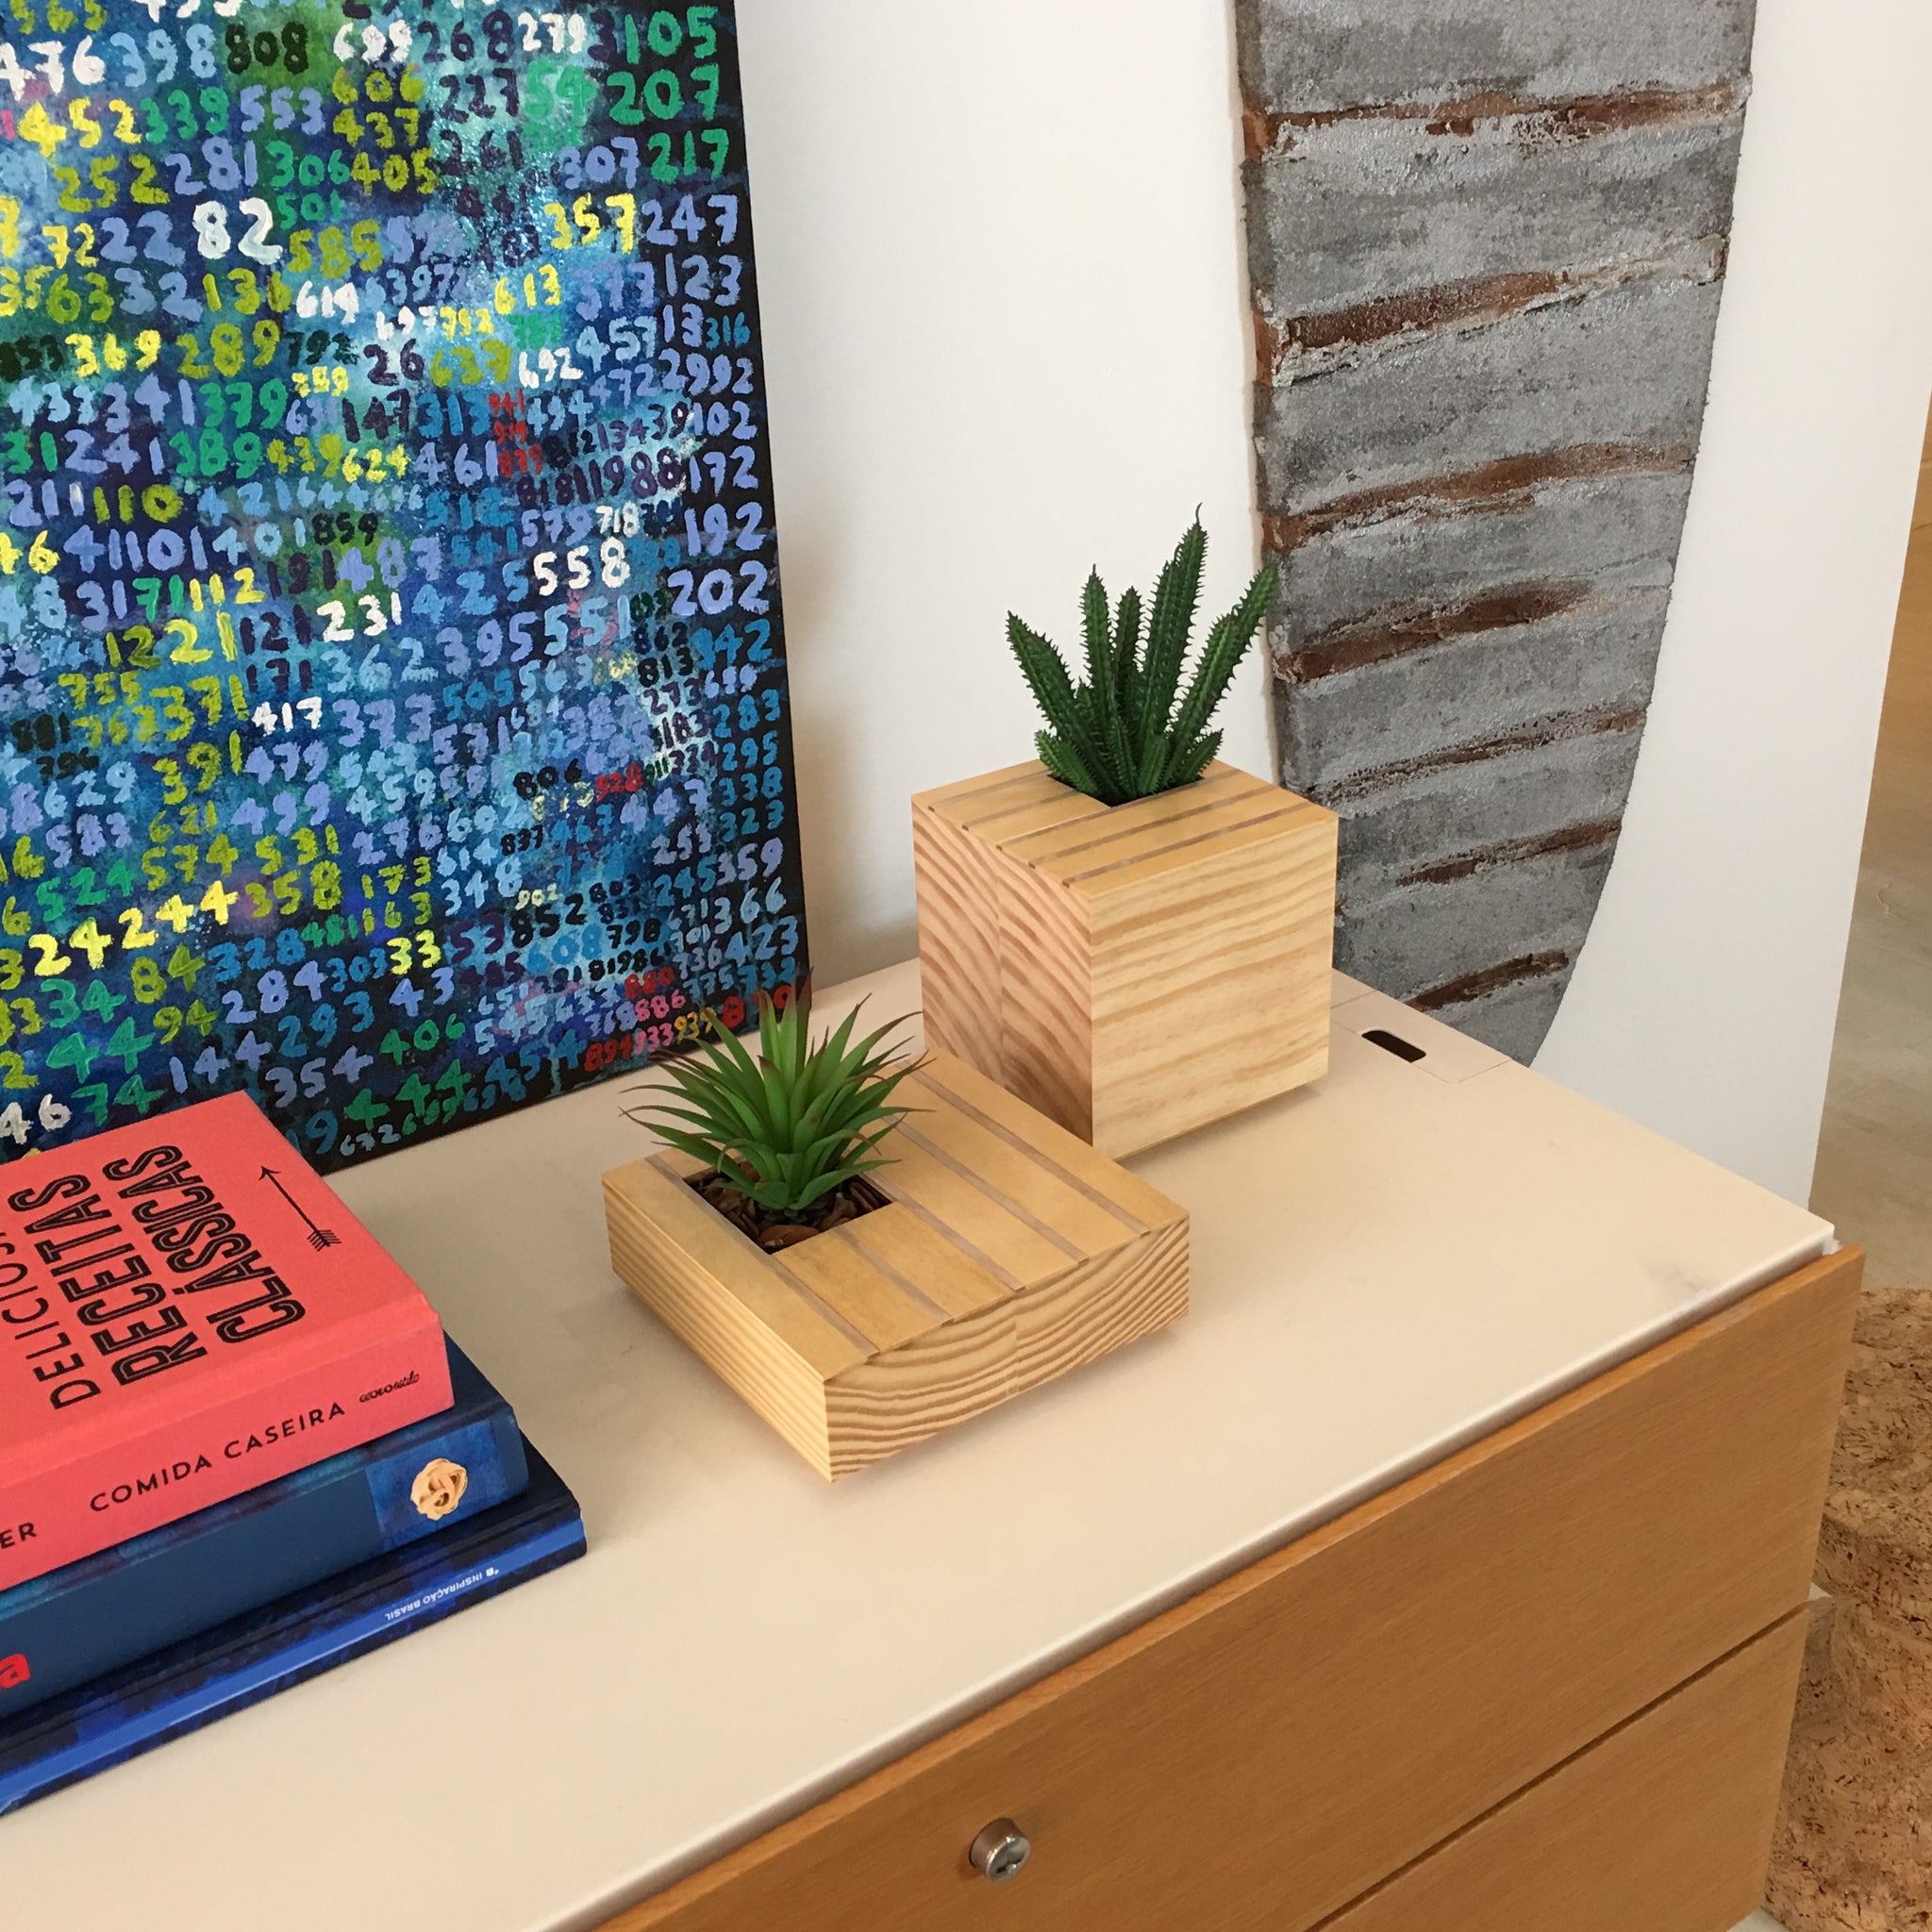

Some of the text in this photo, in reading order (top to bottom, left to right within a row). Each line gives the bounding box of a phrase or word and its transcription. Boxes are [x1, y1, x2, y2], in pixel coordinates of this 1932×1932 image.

[109, 24, 217, 87] 398
[225, 22, 308, 75] 808
[417, 9, 514, 62] 268
[625, 6, 718, 64] 105
[141, 86, 229, 143] 339
[240, 85, 325, 135] 553
[607, 63, 719, 125] 207
[333, 108, 420, 148] 437
[165, 136, 258, 195] 281
[648, 128, 728, 183] 217
[192, 196, 283, 265] 82
[544, 192, 637, 255] 357
[641, 193, 738, 246] 247
[287, 219, 384, 279] 585
[494, 263, 561, 315] 613
[665, 253, 742, 307] 123
[65, 329, 161, 377] 369
[176, 319, 280, 378] 289
[706, 311, 751, 349] 316
[363, 338, 424, 386] 26
[199, 378, 289, 429] 379
[692, 400, 758, 440] 102
[169, 427, 263, 479] 389
[414, 440, 498, 488] 461
[689, 445, 758, 497] 172
[92, 484, 183, 524] 110
[596, 500, 639, 537] 718
[684, 501, 767, 558] 192
[534, 536, 631, 597] 558
[667, 560, 770, 616] 202
[240, 604, 311, 656] 121
[316, 591, 403, 643] 231
[637, 647, 693, 688] 813
[252, 696, 322, 737] 417
[713, 689, 780, 738] 283
[723, 730, 778, 771] 295
[513, 758, 582, 801] 806
[719, 767, 783, 807] 338
[720, 800, 784, 842] 323
[716, 838, 784, 886] 359
[245, 859, 342, 918] 358
[714, 876, 787, 935] 366
[510, 893, 588, 948] 852
[606, 918, 661, 949] 798
[724, 915, 798, 967] 423
[131, 943, 206, 1004] 84
[386, 929, 441, 975] 33
[41, 978, 126, 1028] 34
[153, 999, 219, 1045] 94
[278, 991, 375, 1058] 293
[380, 1013, 465, 1065] 406
[344, 1058, 473, 1131] 444
[102, 1145, 306, 1343] CLÁSSICAS
[8, 1174, 208, 1386] RECEITAS
[90, 1402, 345, 1512] COMIDA CASEIRA
[385, 1600, 421, 1620] BRASIL
[423, 1572, 483, 1604] INSPIRAÇÃO
